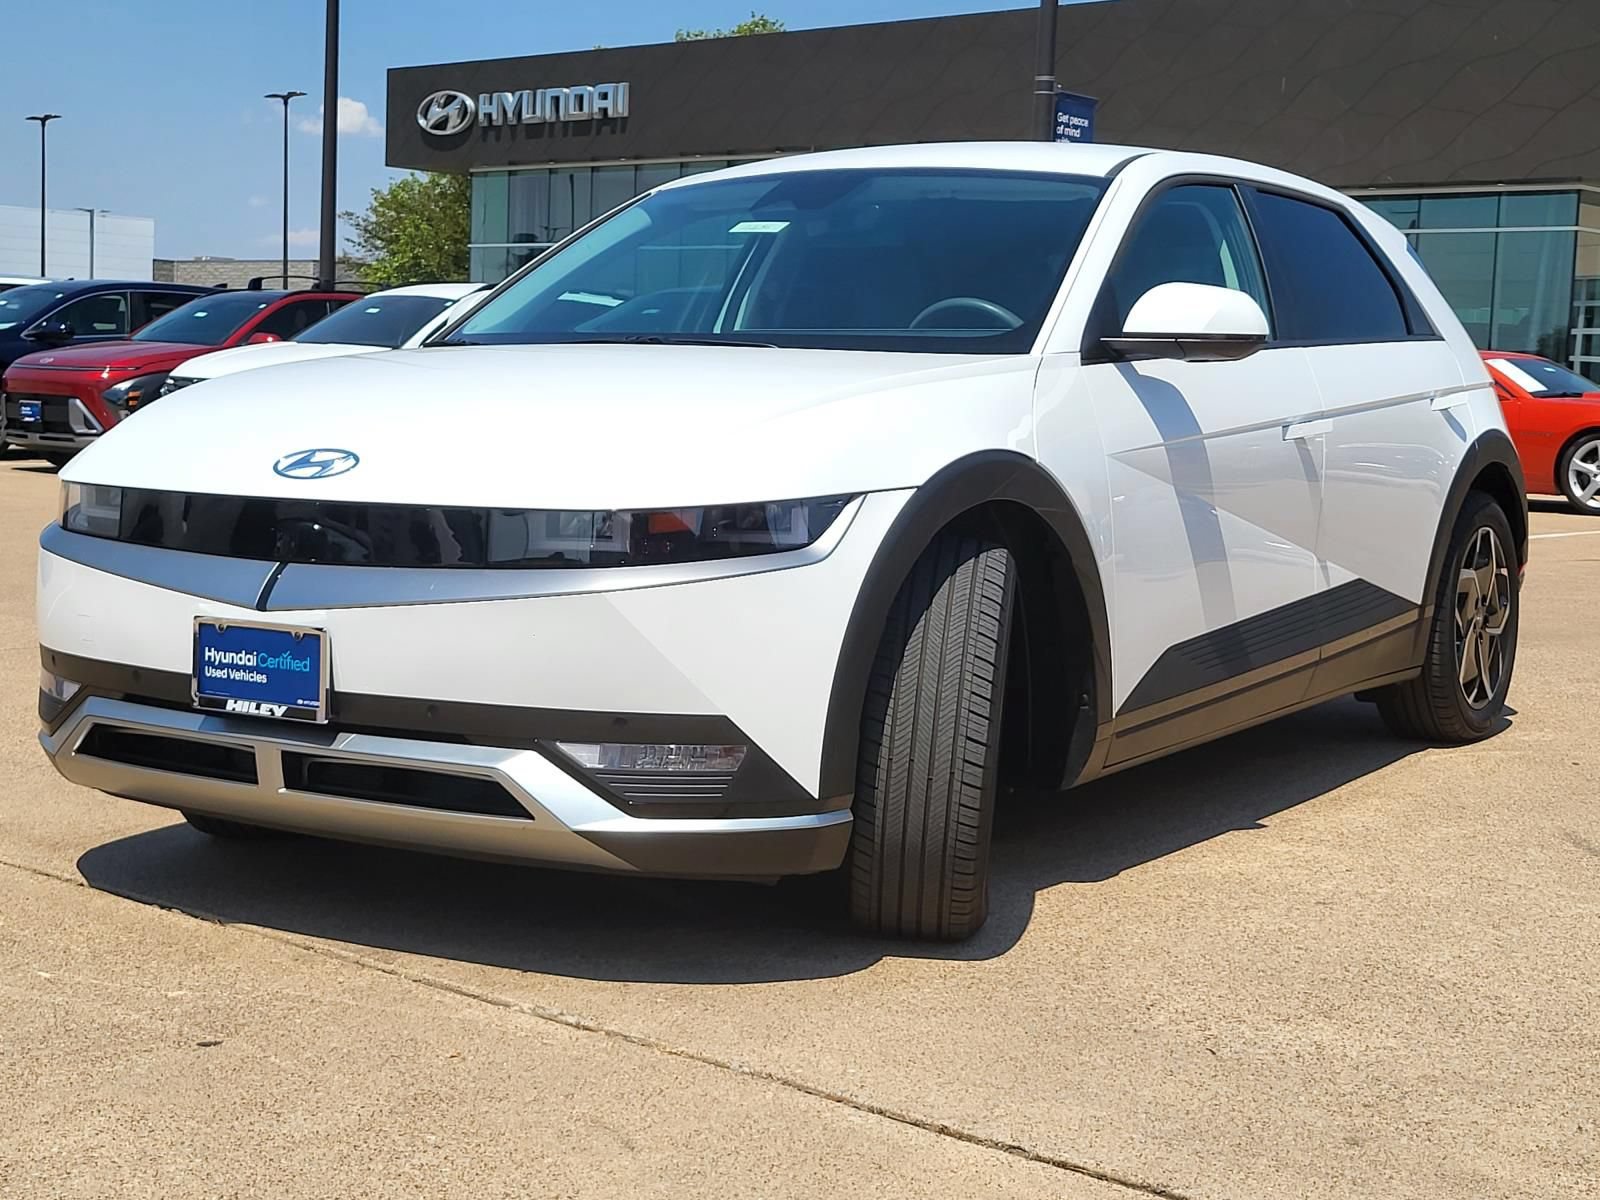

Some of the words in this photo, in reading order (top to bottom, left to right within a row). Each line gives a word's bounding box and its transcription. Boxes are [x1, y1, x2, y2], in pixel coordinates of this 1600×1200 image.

[478, 82, 630, 127] HYUNDAI
[1057, 112, 1069, 124] Get
[1069, 116, 1089, 128] peace
[1056, 124, 1064, 135] of
[1064, 127, 1081, 138] mind
[204, 646, 257, 667] Hyundai
[258, 651, 310, 672] Certified
[204, 666, 228, 679] Used
[229, 669, 268, 683] Vehicles
[225, 699, 288, 717] HILEY
